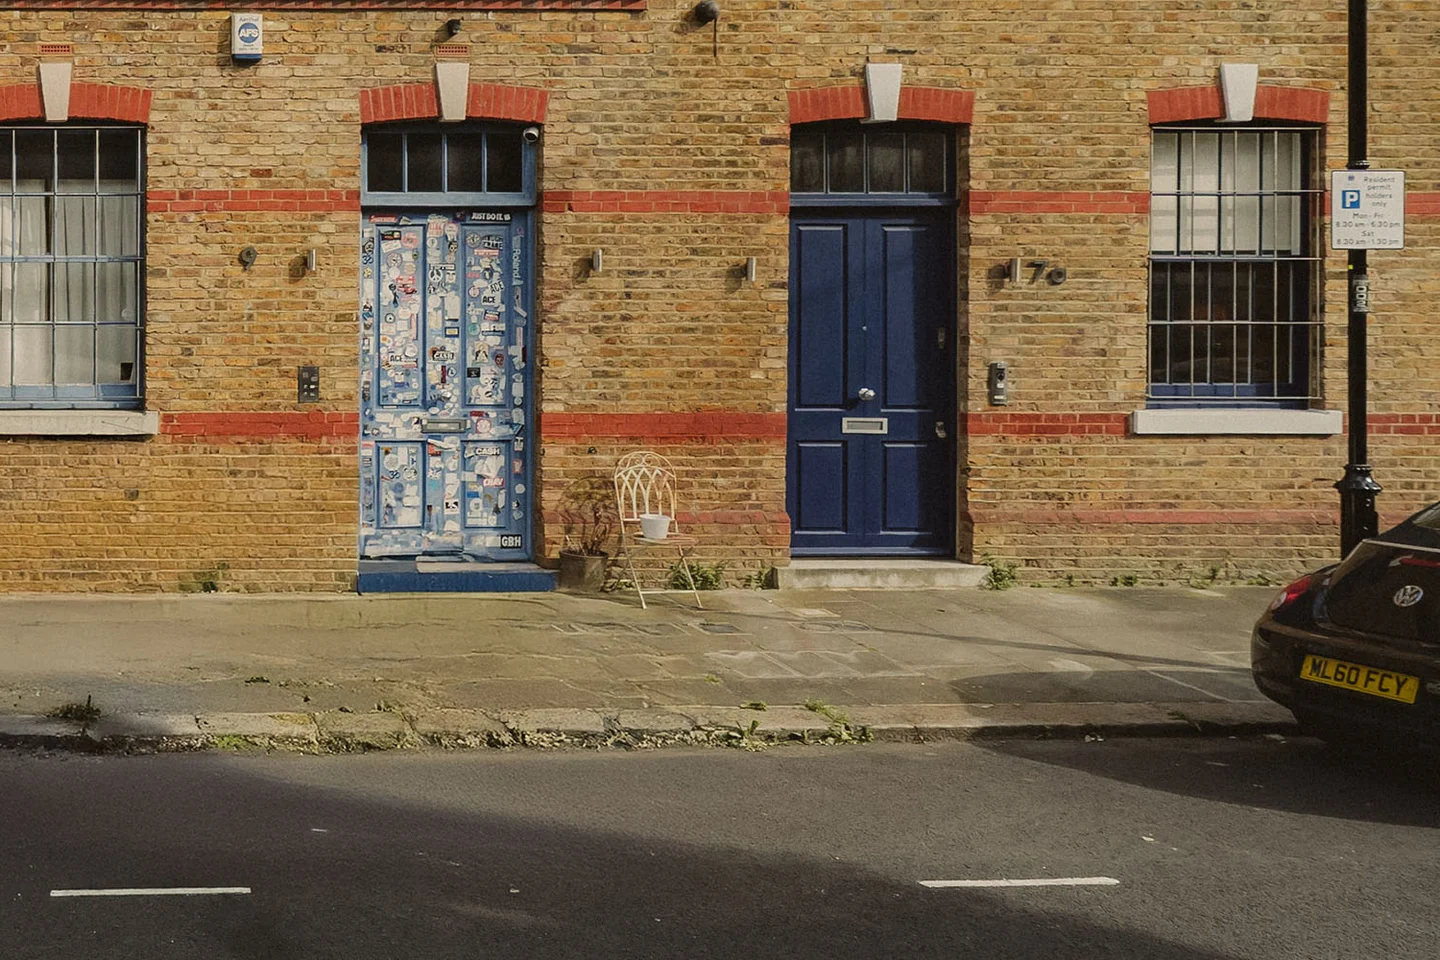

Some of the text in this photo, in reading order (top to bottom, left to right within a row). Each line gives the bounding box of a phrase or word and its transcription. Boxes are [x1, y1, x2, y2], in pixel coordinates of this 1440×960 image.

[240, 28, 259, 38] AFS
[1345, 191, 1359, 208] P
[471, 212, 485, 220] JUST
[513, 249, 521, 278] Roland
[490, 281, 504, 293] ACE
[475, 447, 500, 455] CASH
[501, 536, 521, 547] GBH
[1309, 658, 1408, 695] ML60 FCY
